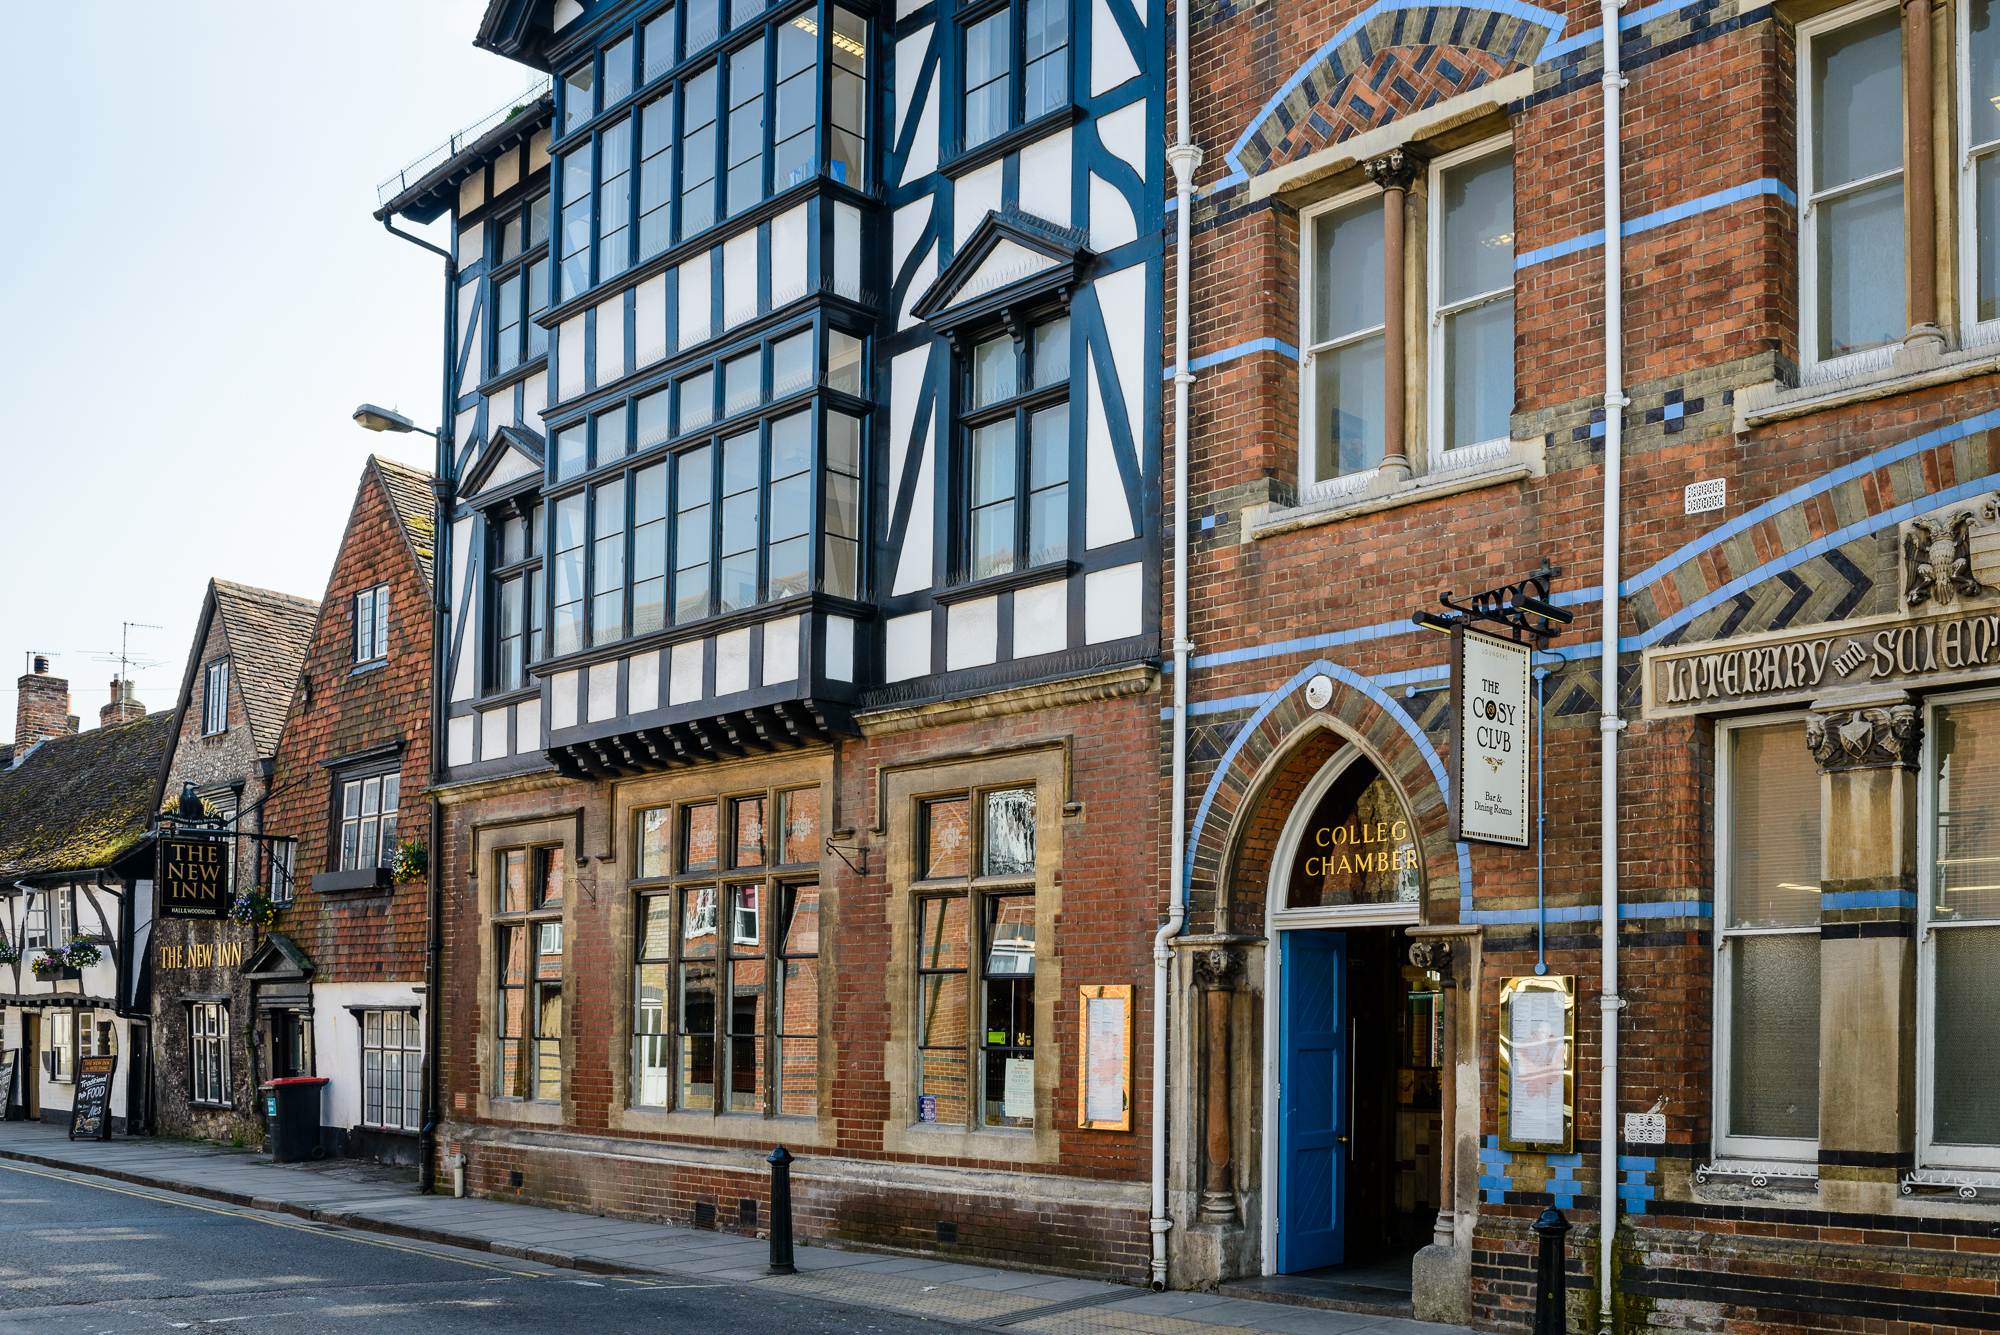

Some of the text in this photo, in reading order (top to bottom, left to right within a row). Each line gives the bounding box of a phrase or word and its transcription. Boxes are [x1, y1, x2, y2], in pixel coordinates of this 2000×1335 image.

[1481, 648, 1508, 660] LOUNGERS
[1666, 614, 2000, 702] LITERARY and SCIEN
[1481, 678, 1500, 695] THE
[1472, 696, 1517, 726] COSY
[1476, 725, 1512, 753] CLUB
[1484, 791, 1502, 803] Bar &
[1474, 801, 1513, 816] Dining Rooms
[1315, 820, 1408, 847] COLLEG
[171, 843, 217, 863] THE
[1305, 849, 1418, 876] CHAMBER
[167, 862, 221, 881] NEW
[172, 881, 217, 899] INN
[160, 941, 242, 969] THE NEW INN
[80, 1074, 107, 1088] Traditional
[86, 1086, 105, 1101] FOOD
